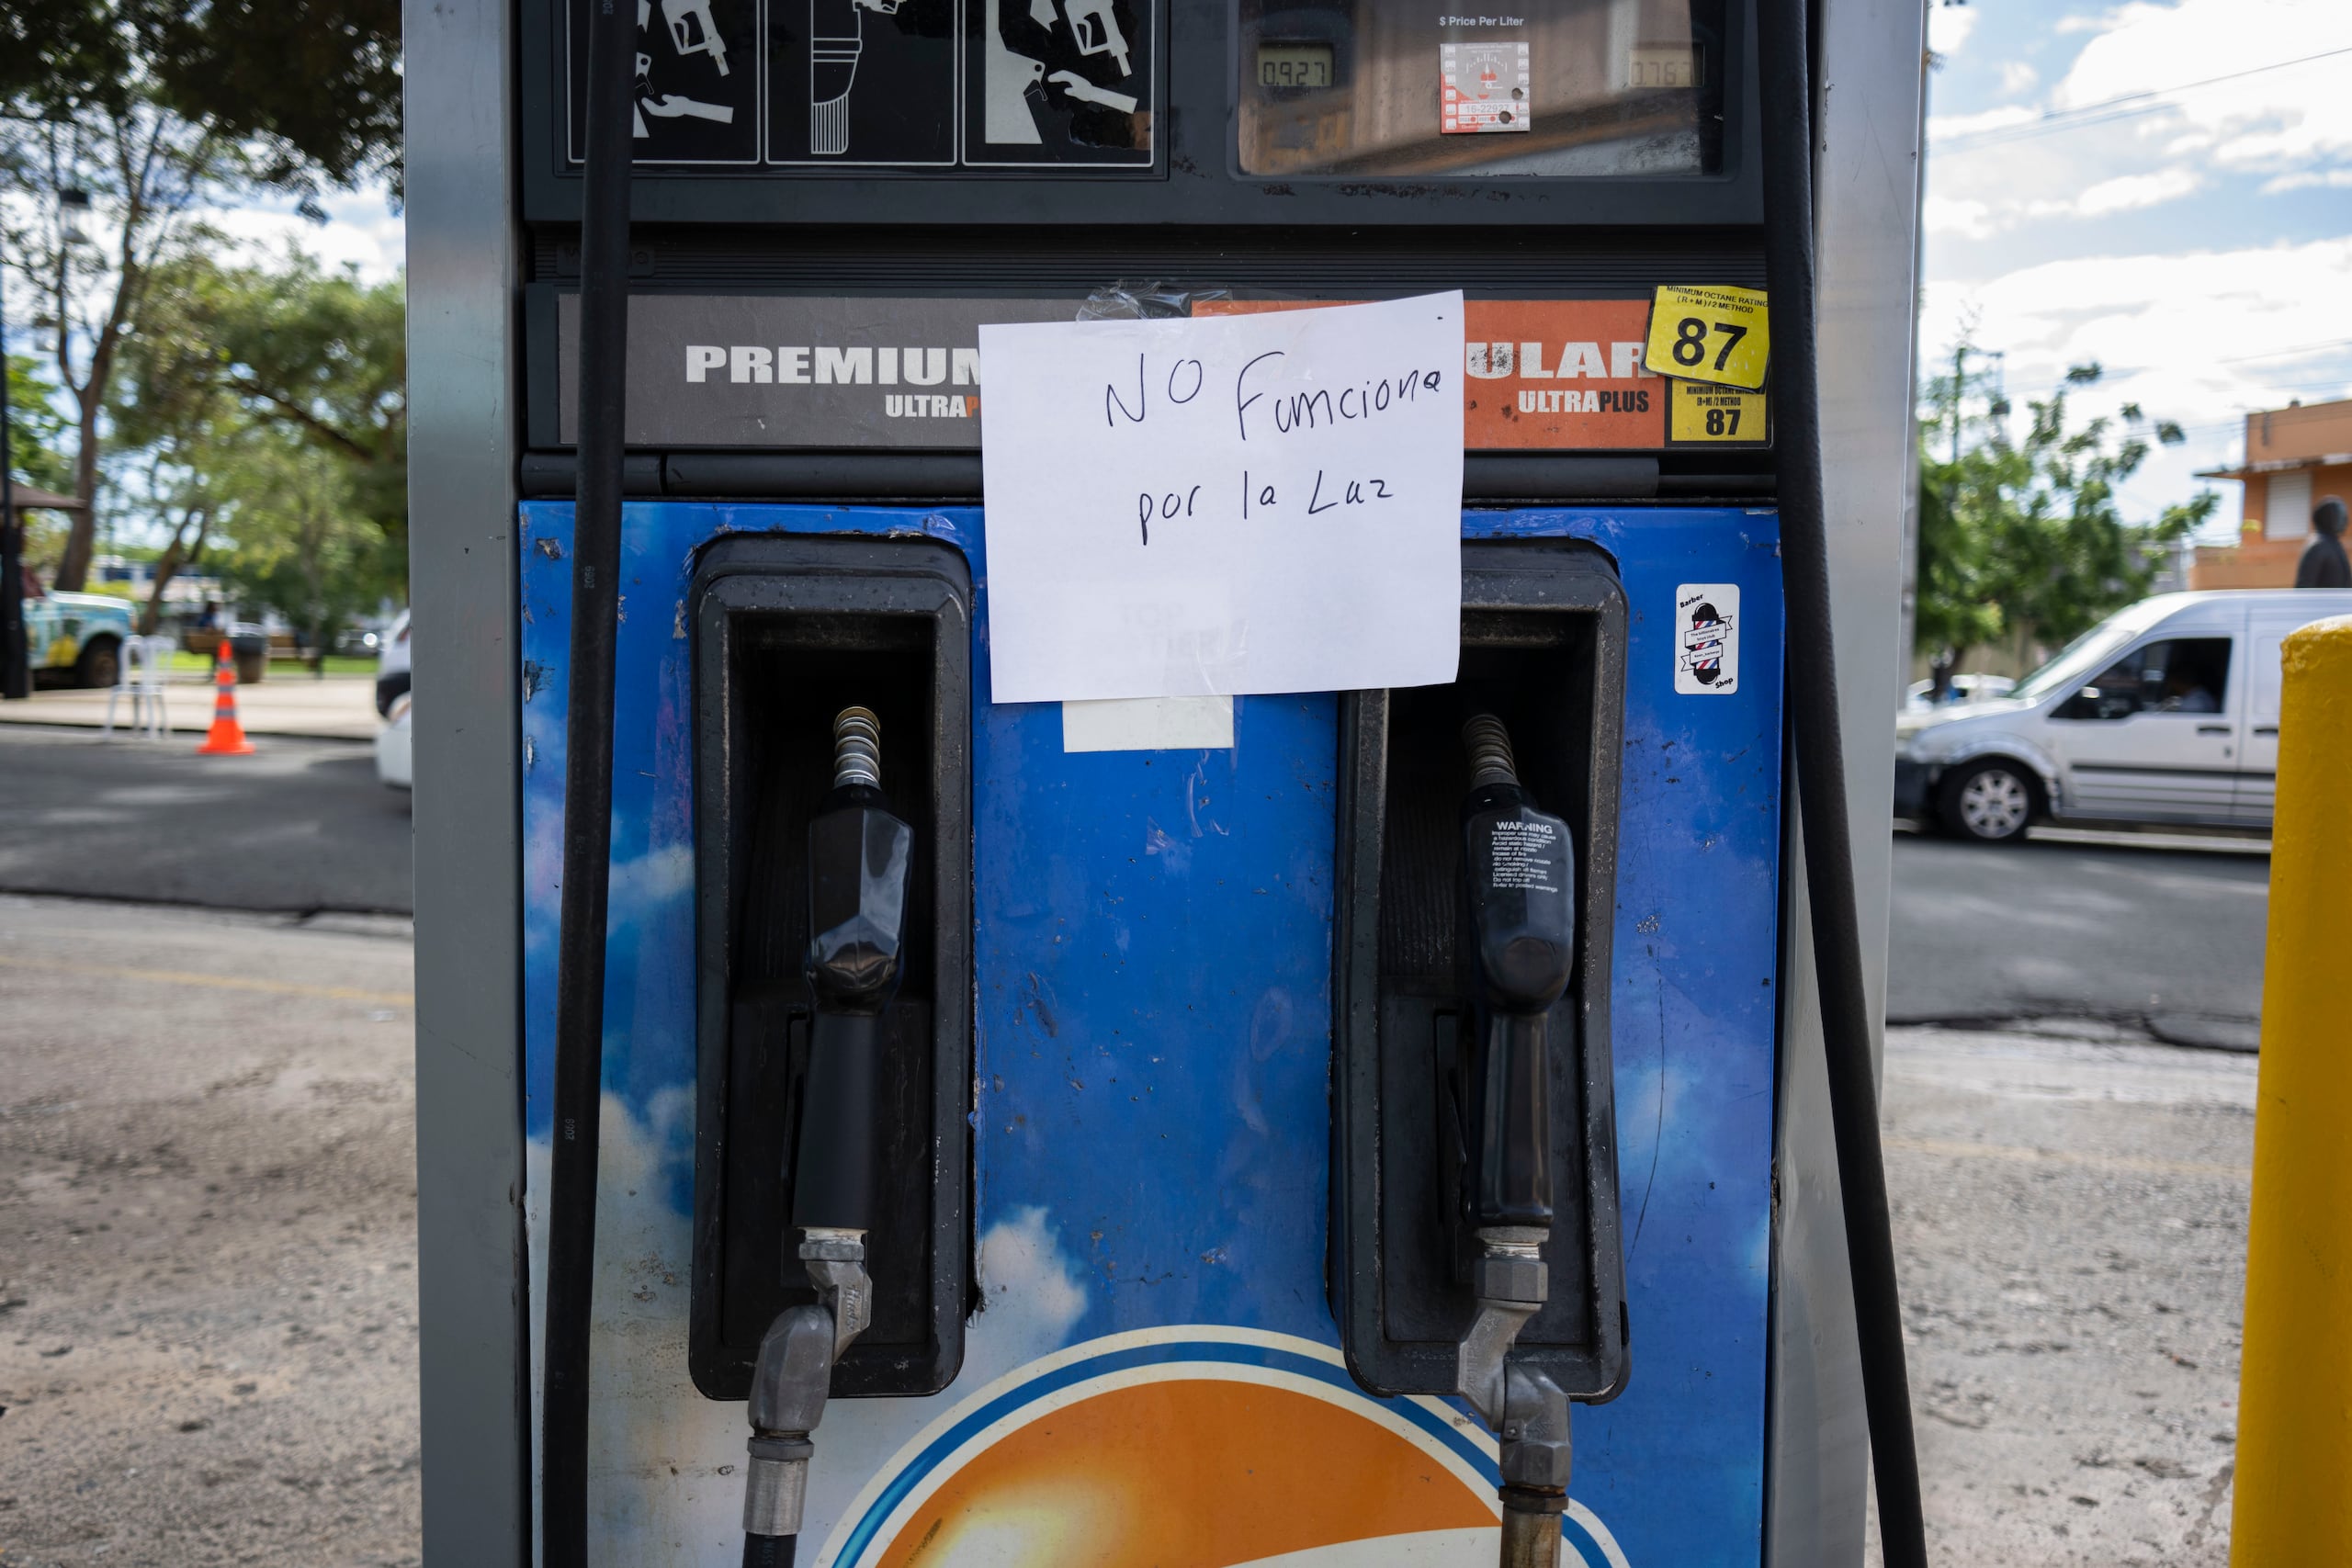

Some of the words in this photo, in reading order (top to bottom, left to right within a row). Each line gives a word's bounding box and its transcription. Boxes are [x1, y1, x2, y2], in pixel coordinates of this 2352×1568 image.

[1439, 17, 1446, 27] $
[1449, 17, 1476, 26] Price
[1479, 17, 1497, 26] Per
[1499, 17, 1524, 26] Liter
[1263, 62, 1325, 85] 0.927
[1667, 286, 1702, 297] MINIMUM
[1703, 291, 1736, 302] OCTANE
[1738, 297, 1769, 308] RATING
[1718, 303, 1754, 314] METHOD
[1672, 317, 1747, 371] 87
[1106, 353, 1203, 427] NO
[1519, 390, 1648, 412] ULTRAPLUS
[1720, 397, 1741, 406] METHOD
[1706, 409, 1741, 436] 87
[1139, 485, 1201, 546] por
[1244, 470, 1277, 519] la
[1308, 470, 1395, 514] Luz
[1679, 593, 1704, 609] Barber
[1715, 677, 1734, 689] Shop
[1496, 821, 1553, 834] WARNING
